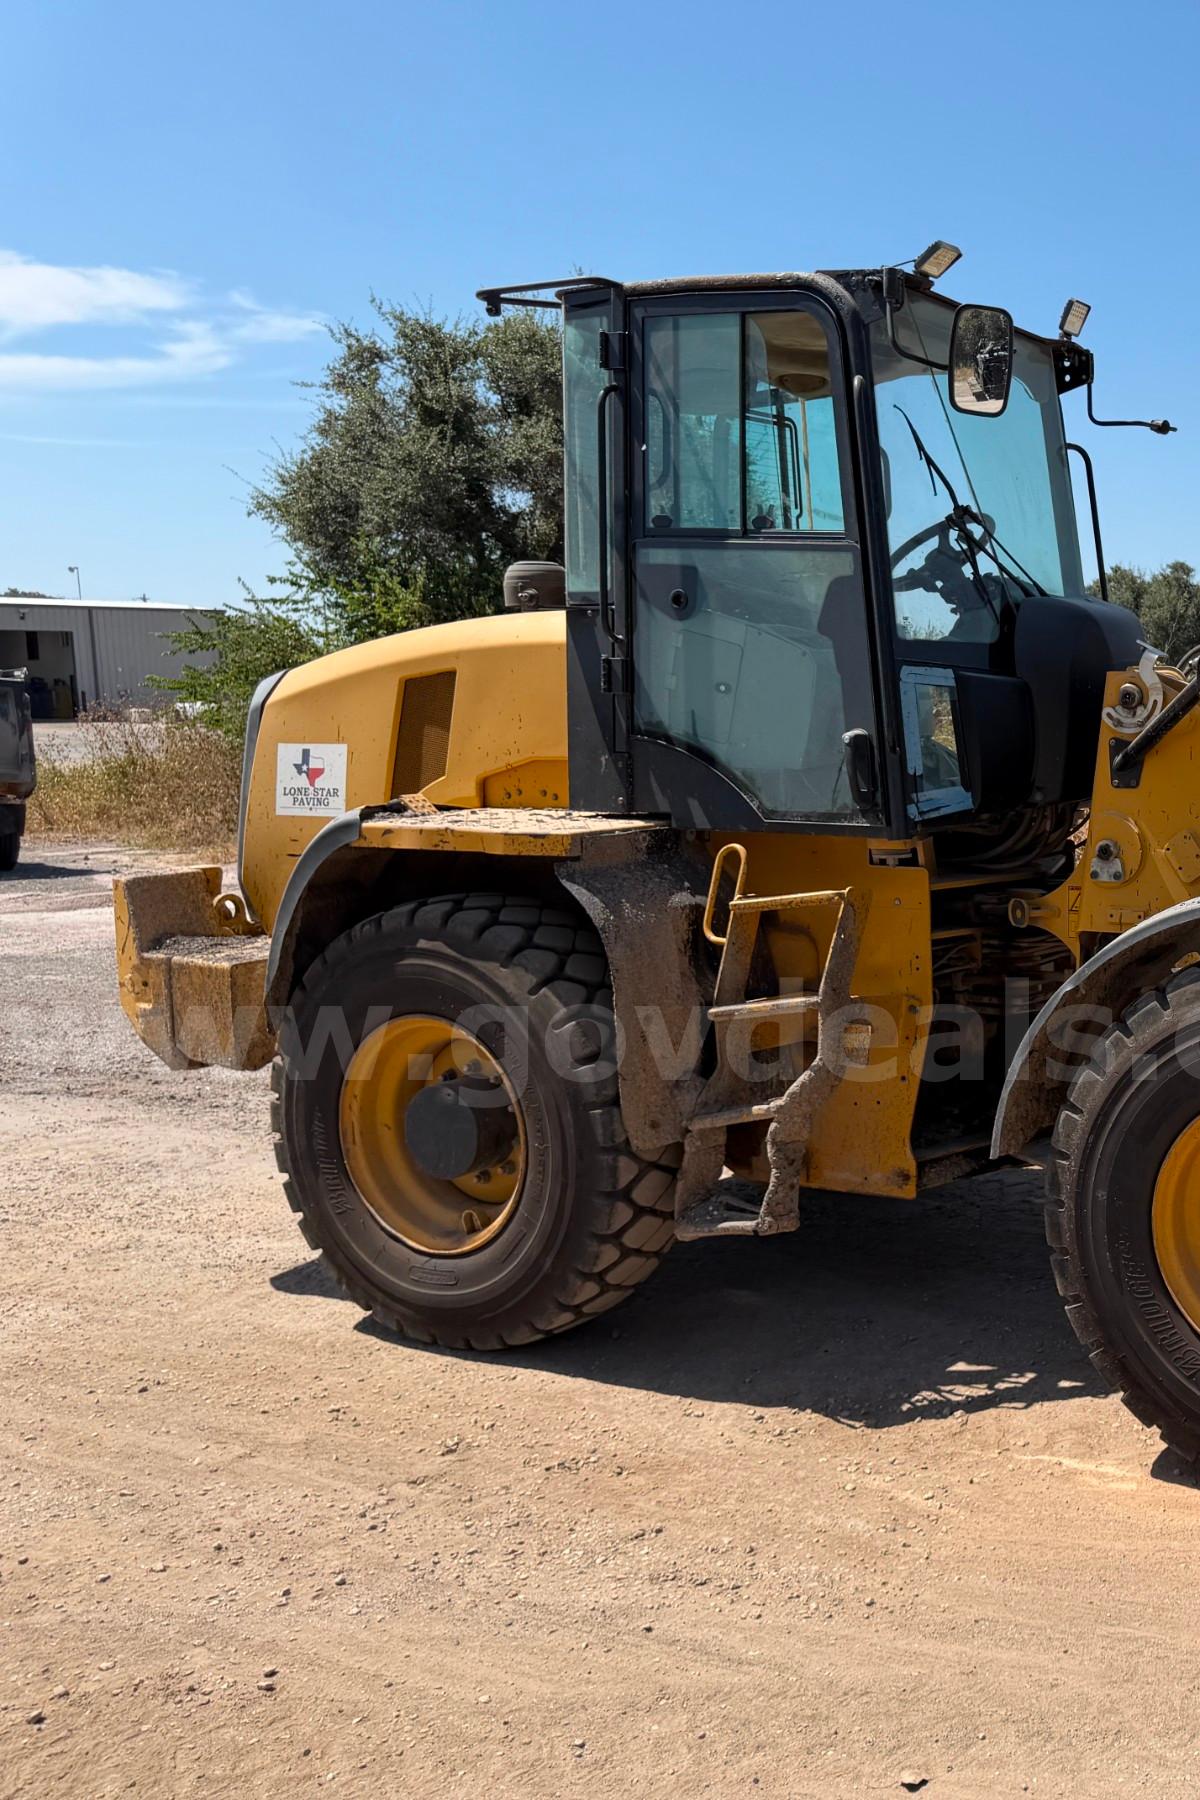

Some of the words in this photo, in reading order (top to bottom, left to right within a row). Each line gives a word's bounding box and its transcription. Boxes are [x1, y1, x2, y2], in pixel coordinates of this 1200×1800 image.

[283, 787, 310, 797] LONE
[313, 787, 339, 798] STAR
[292, 797, 330, 807] PAVING
